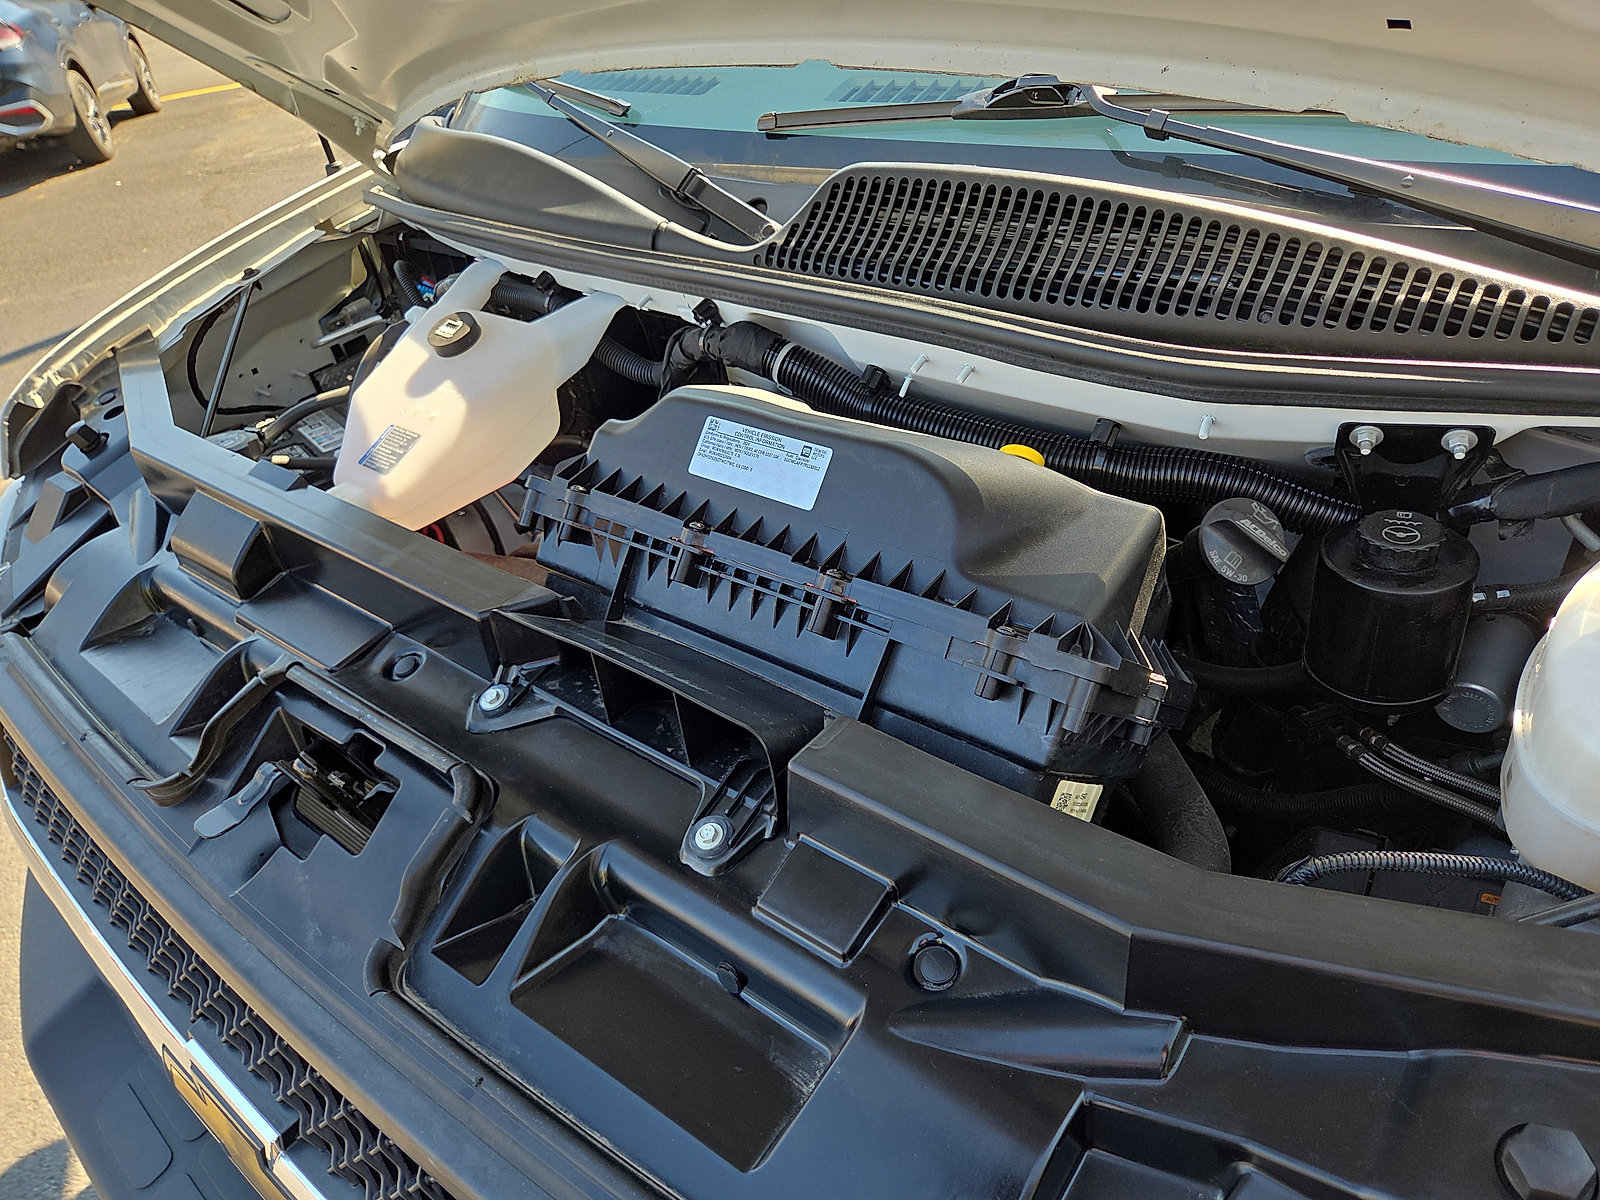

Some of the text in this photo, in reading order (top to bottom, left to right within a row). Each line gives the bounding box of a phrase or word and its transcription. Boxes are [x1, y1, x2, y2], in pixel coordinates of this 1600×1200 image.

[734, 431, 785, 449] CONTROL INFORMATION
[742, 428, 782, 442] VEHICLE EMISSION
[1239, 518, 1287, 557] ACDelco
[1209, 549, 1248, 582] SAE 5W-30
